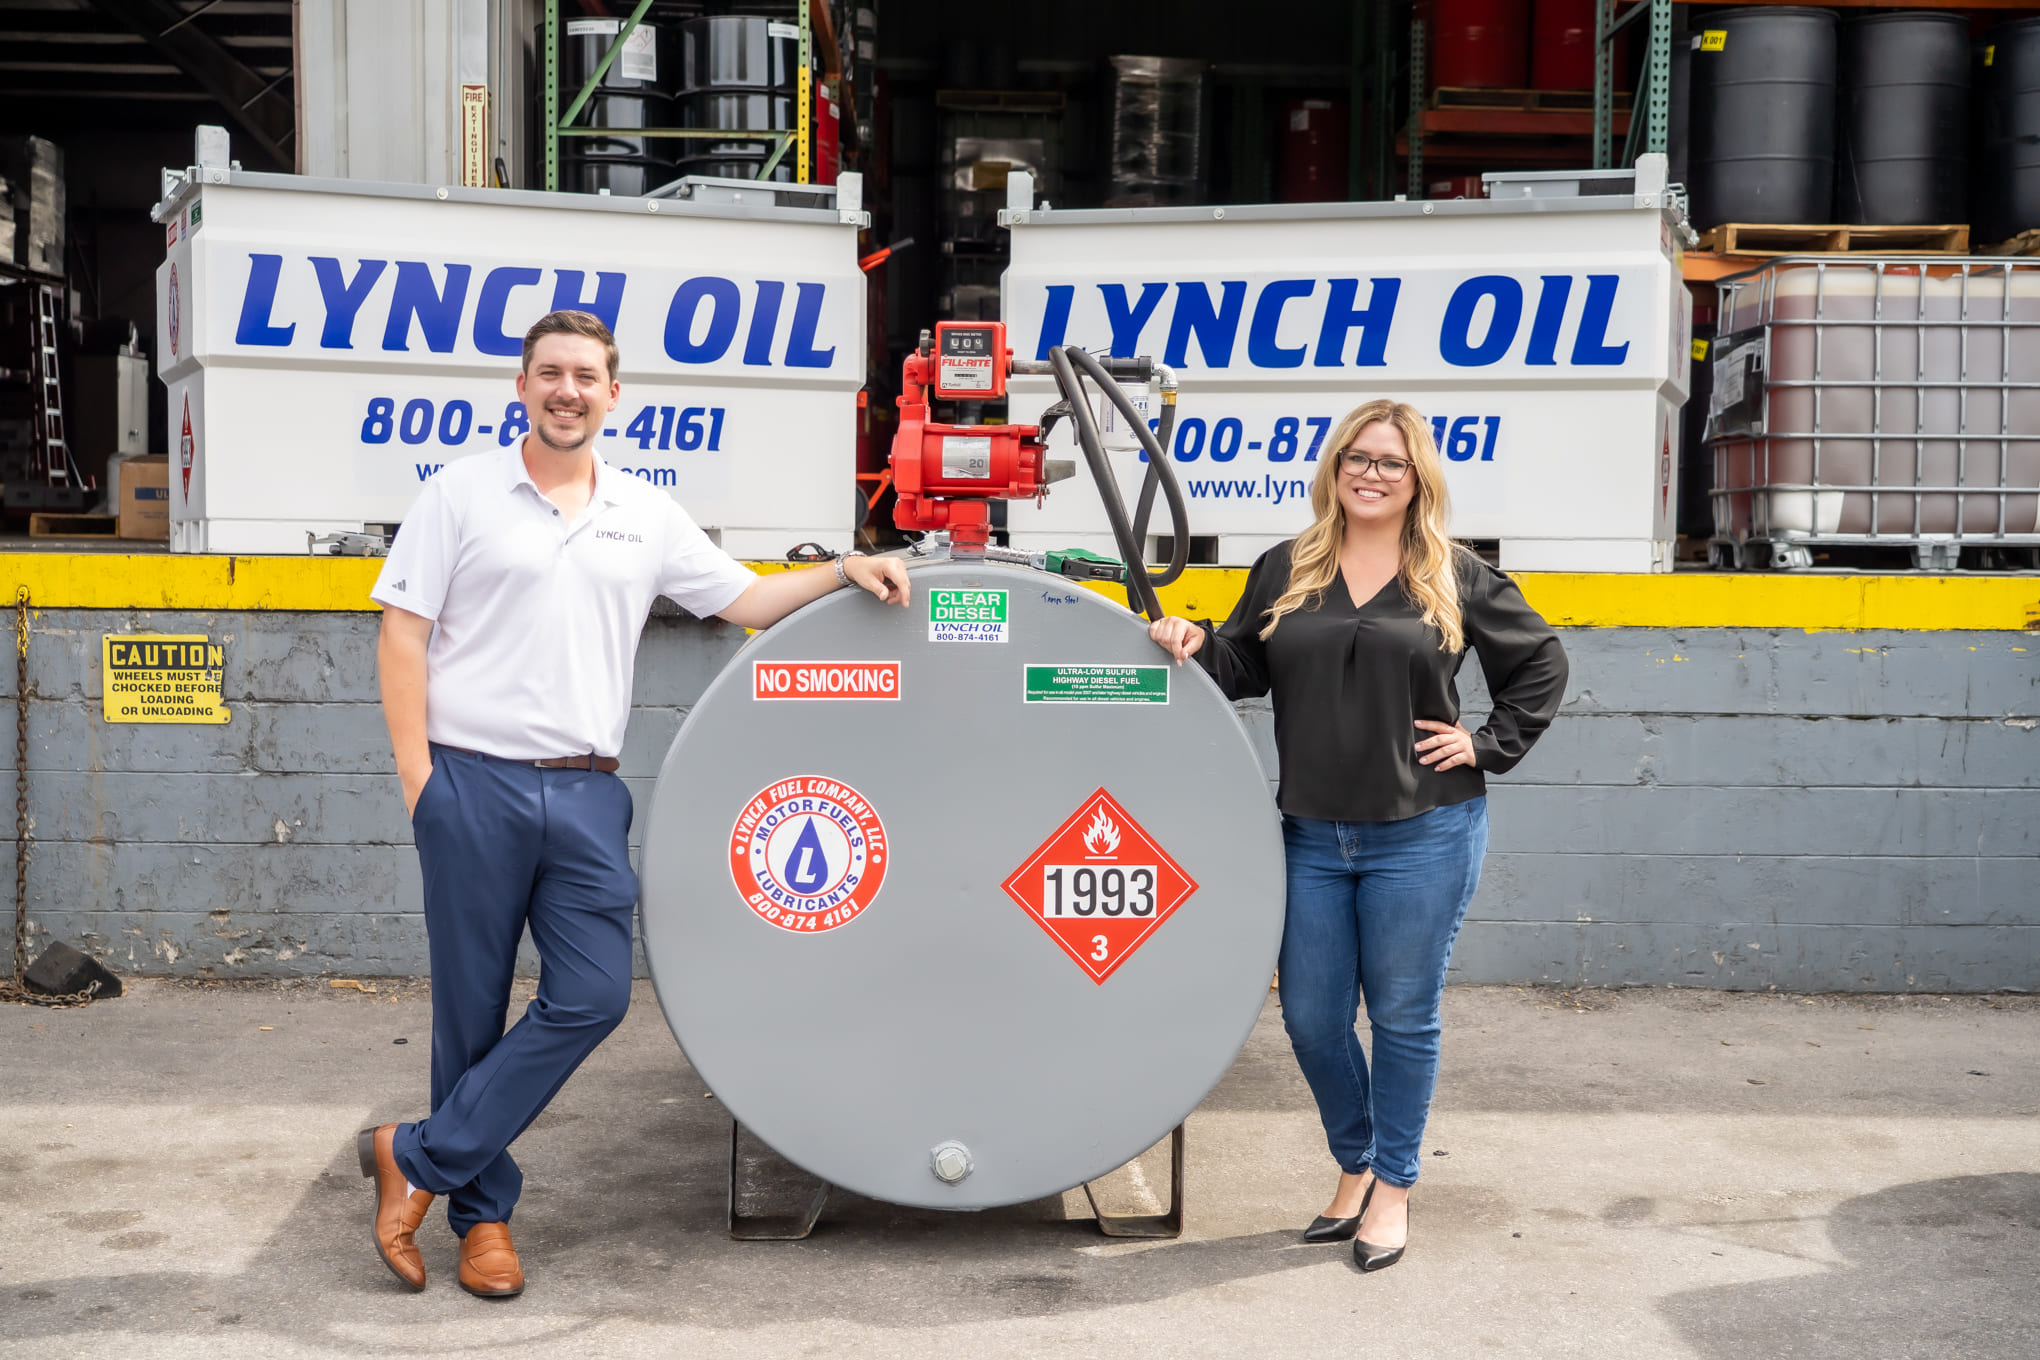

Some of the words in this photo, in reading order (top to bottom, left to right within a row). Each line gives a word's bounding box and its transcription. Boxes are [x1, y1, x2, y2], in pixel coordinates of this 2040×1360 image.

[465, 92, 482, 102] FIRE
[235, 253, 627, 357] LYNCH
[663, 276, 836, 368] OIL
[1439, 274, 1630, 367] OIL
[942, 358, 991, 367] FILL-RITE
[361, 397, 725, 451] 800-8-4161
[969, 459, 984, 468] 20
[596, 530, 625, 541] LYNCH
[628, 534, 644, 543] OIL
[937, 593, 1000, 606] CLEAR
[936, 607, 1002, 620] DIESEL
[934, 623, 979, 633] LYNCH
[982, 624, 1003, 633] OIL
[936, 633, 999, 641] 800-874-4161
[112, 644, 223, 667] CAUTION
[113, 672, 163, 681] WHEELS
[166, 672, 201, 681] MUST
[759, 669, 791, 692] NO
[795, 669, 895, 692] SMOKING
[1053, 676, 1089, 684] HIGHWAY
[1120, 677, 1140, 685] FUEL
[112, 683, 171, 692] CHOCKED
[175, 684, 221, 693] BEFORE
[140, 695, 194, 704] LOADING
[121, 706, 138, 715] OR
[142, 707, 214, 716] UNLOADING
[735, 801, 768, 844] LYNCH
[769, 780, 804, 803] FUEL
[807, 779, 873, 827] COMPANY,
[866, 826, 884, 850] LLC
[756, 799, 813, 841] MOTOR
[818, 800, 863, 848] FUELS
[795, 847, 816, 884] L
[756, 870, 858, 911] LUBRICANTS
[1046, 868, 1154, 917] 1993
[823, 898, 860, 926] 4161
[1090, 934, 1108, 961] 3
